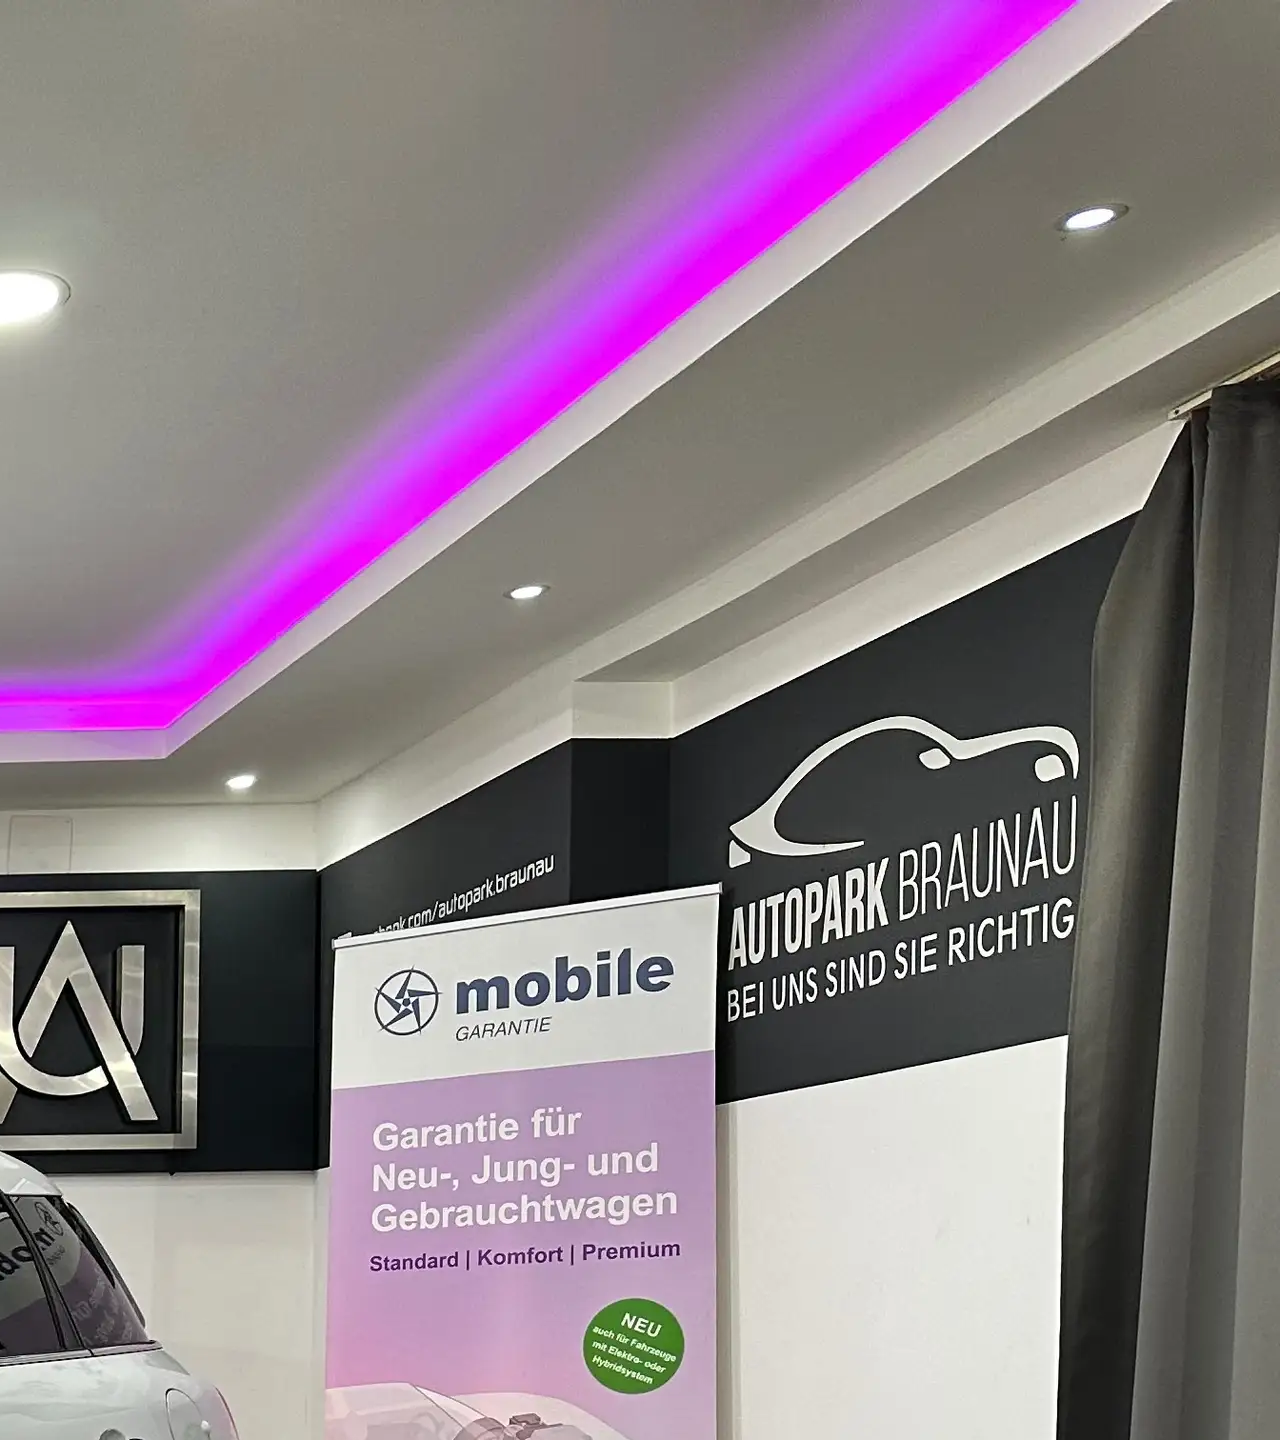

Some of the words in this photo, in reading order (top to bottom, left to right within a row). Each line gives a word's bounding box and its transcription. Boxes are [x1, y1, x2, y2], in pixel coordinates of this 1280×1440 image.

[728, 857, 890, 970] AUTOPARK
[899, 796, 1077, 921] BRAUNAU
[728, 982, 764, 1022] BEI
[773, 968, 818, 1010] UNS
[825, 950, 886, 997] SIND
[894, 933, 938, 979] SIE
[948, 898, 1075, 966] RICHTIG
[456, 948, 675, 1014] mobile
[455, 1016, 553, 1042] GARANTIE
[373, 1113, 519, 1152] Garantie
[532, 1107, 582, 1139] für
[372, 1163, 460, 1193] Neu-,
[471, 1155, 575, 1188] Jung-
[587, 1143, 659, 1176] und
[371, 1190, 678, 1233] Gebrauchtwagen
[370, 1249, 459, 1272] Standard
[477, 1244, 564, 1267] Komfort
[582, 1241, 681, 1262] Premium
[592, 1326, 615, 1340] auch
[616, 1333, 630, 1345] für
[630, 1338, 677, 1362] Fahrzeuge
[621, 1312, 662, 1338] NEU
[592, 1340, 607, 1352] mit
[644, 1361, 666, 1374] oder
[592, 1355, 654, 1384] Hybridsystem
